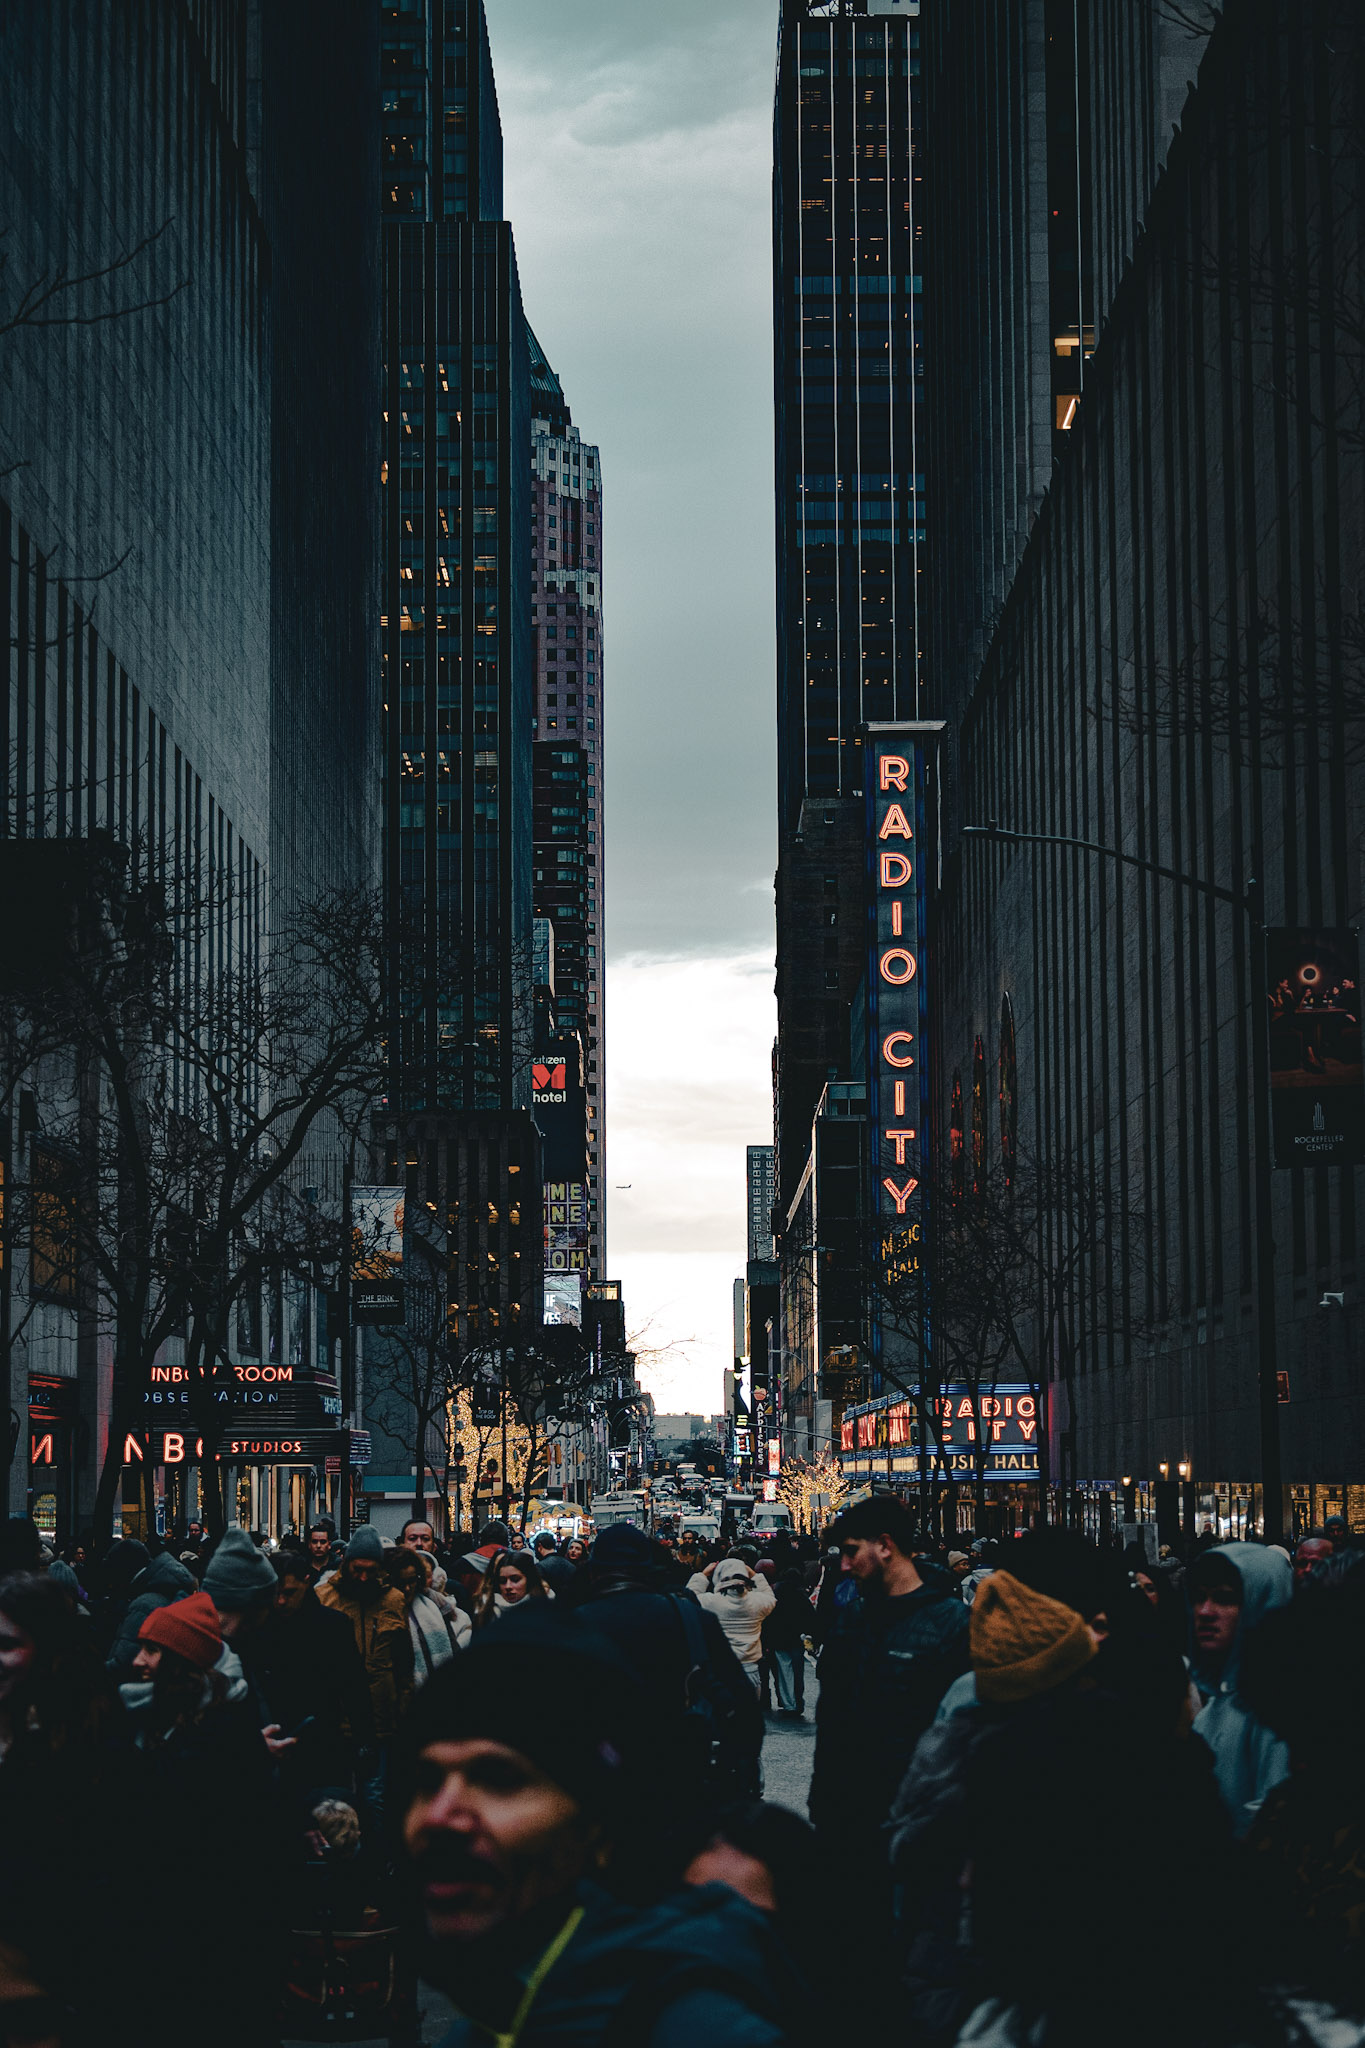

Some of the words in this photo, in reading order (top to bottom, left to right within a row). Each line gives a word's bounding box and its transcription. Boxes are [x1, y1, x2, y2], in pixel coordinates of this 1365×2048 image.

[879, 755, 916, 985] RADIO
[532, 1090, 566, 1103] hotel
[883, 1031, 918, 1214] CITY
[1294, 1134, 1345, 1144] ROCKEFELLER
[1306, 1143, 1334, 1152] CENTER
[543, 1183, 582, 1201] ME
[543, 1204, 582, 1224] NE
[543, 1250, 585, 1268] OM
[233, 1365, 294, 1383] ROOM
[935, 1395, 1036, 1418] RADIO
[231, 1441, 303, 1454] STUDIOS
[930, 1454, 988, 1470] MUSI
[995, 1454, 1040, 1470] HALL
